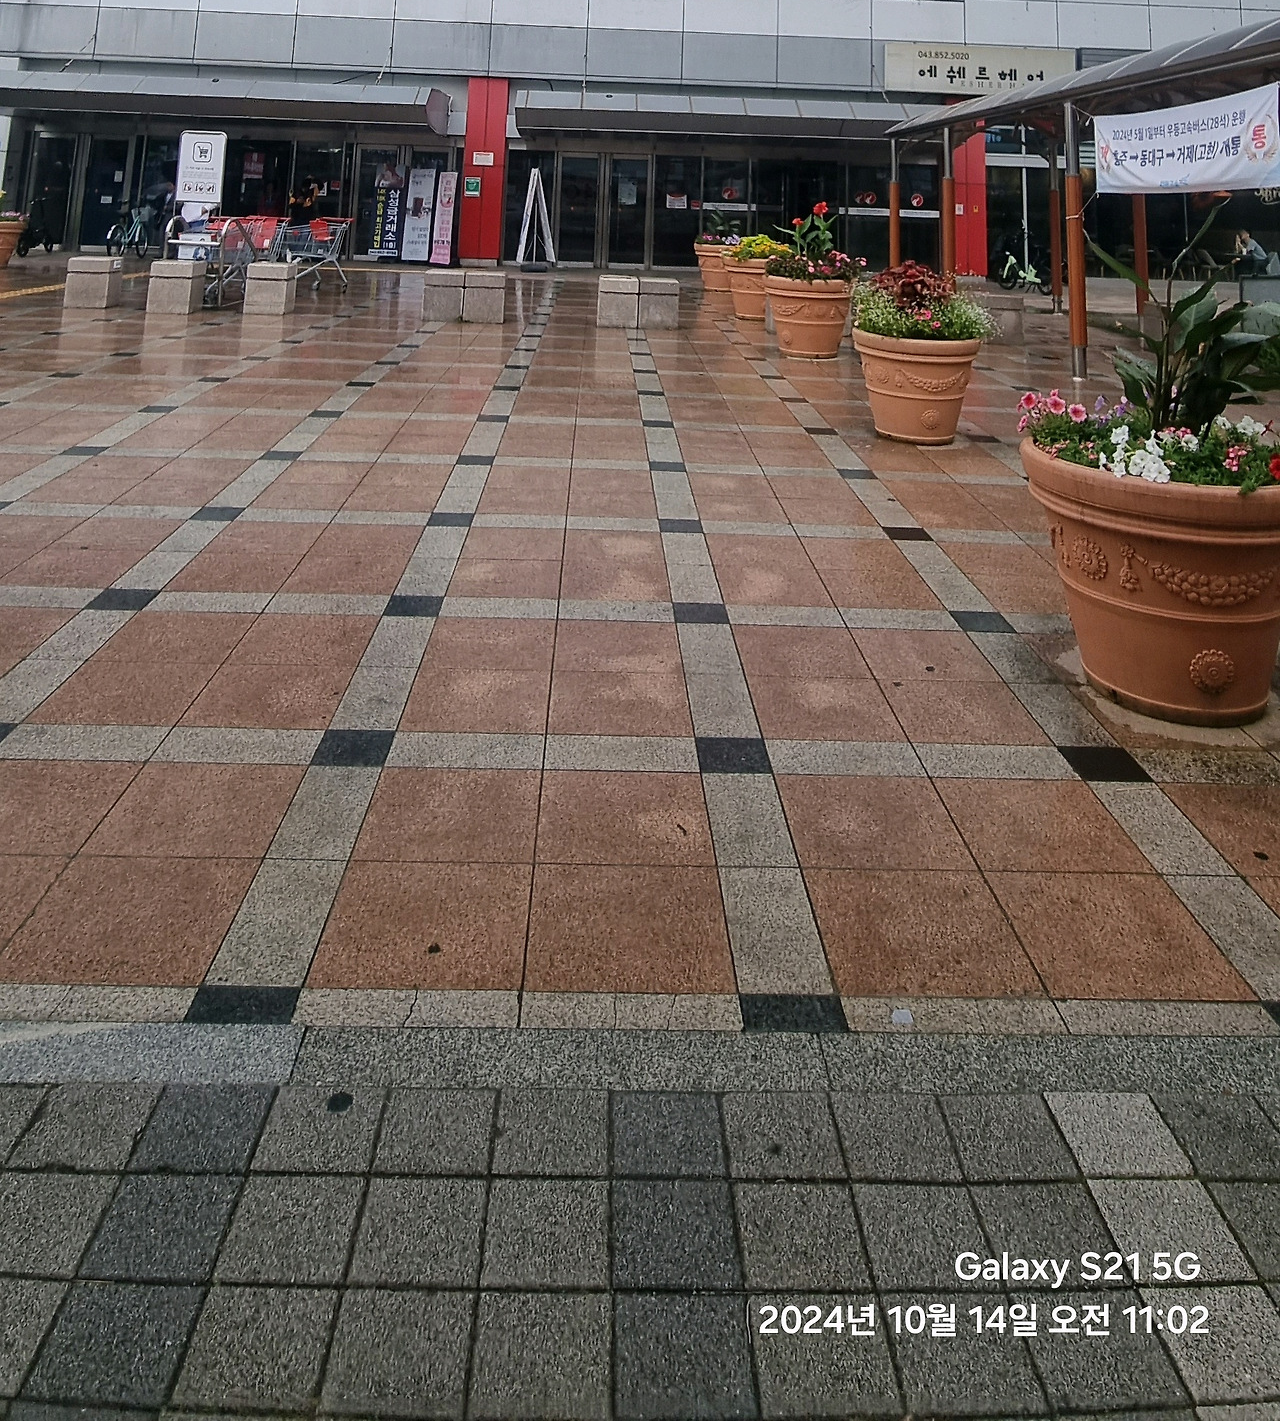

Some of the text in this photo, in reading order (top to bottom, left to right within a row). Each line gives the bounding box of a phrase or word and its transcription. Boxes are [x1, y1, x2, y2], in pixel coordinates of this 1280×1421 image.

[918, 50, 970, 61] 043.852.5020
[1112, 129, 1133, 142] 2024년
[1133, 128, 1144, 141] 5월
[1167, 113, 1230, 137] 우등고속버스(28석)
[1231, 109, 1246, 127] 운행
[1252, 123, 1267, 149] 통
[1139, 148, 1164, 167] 동대구
